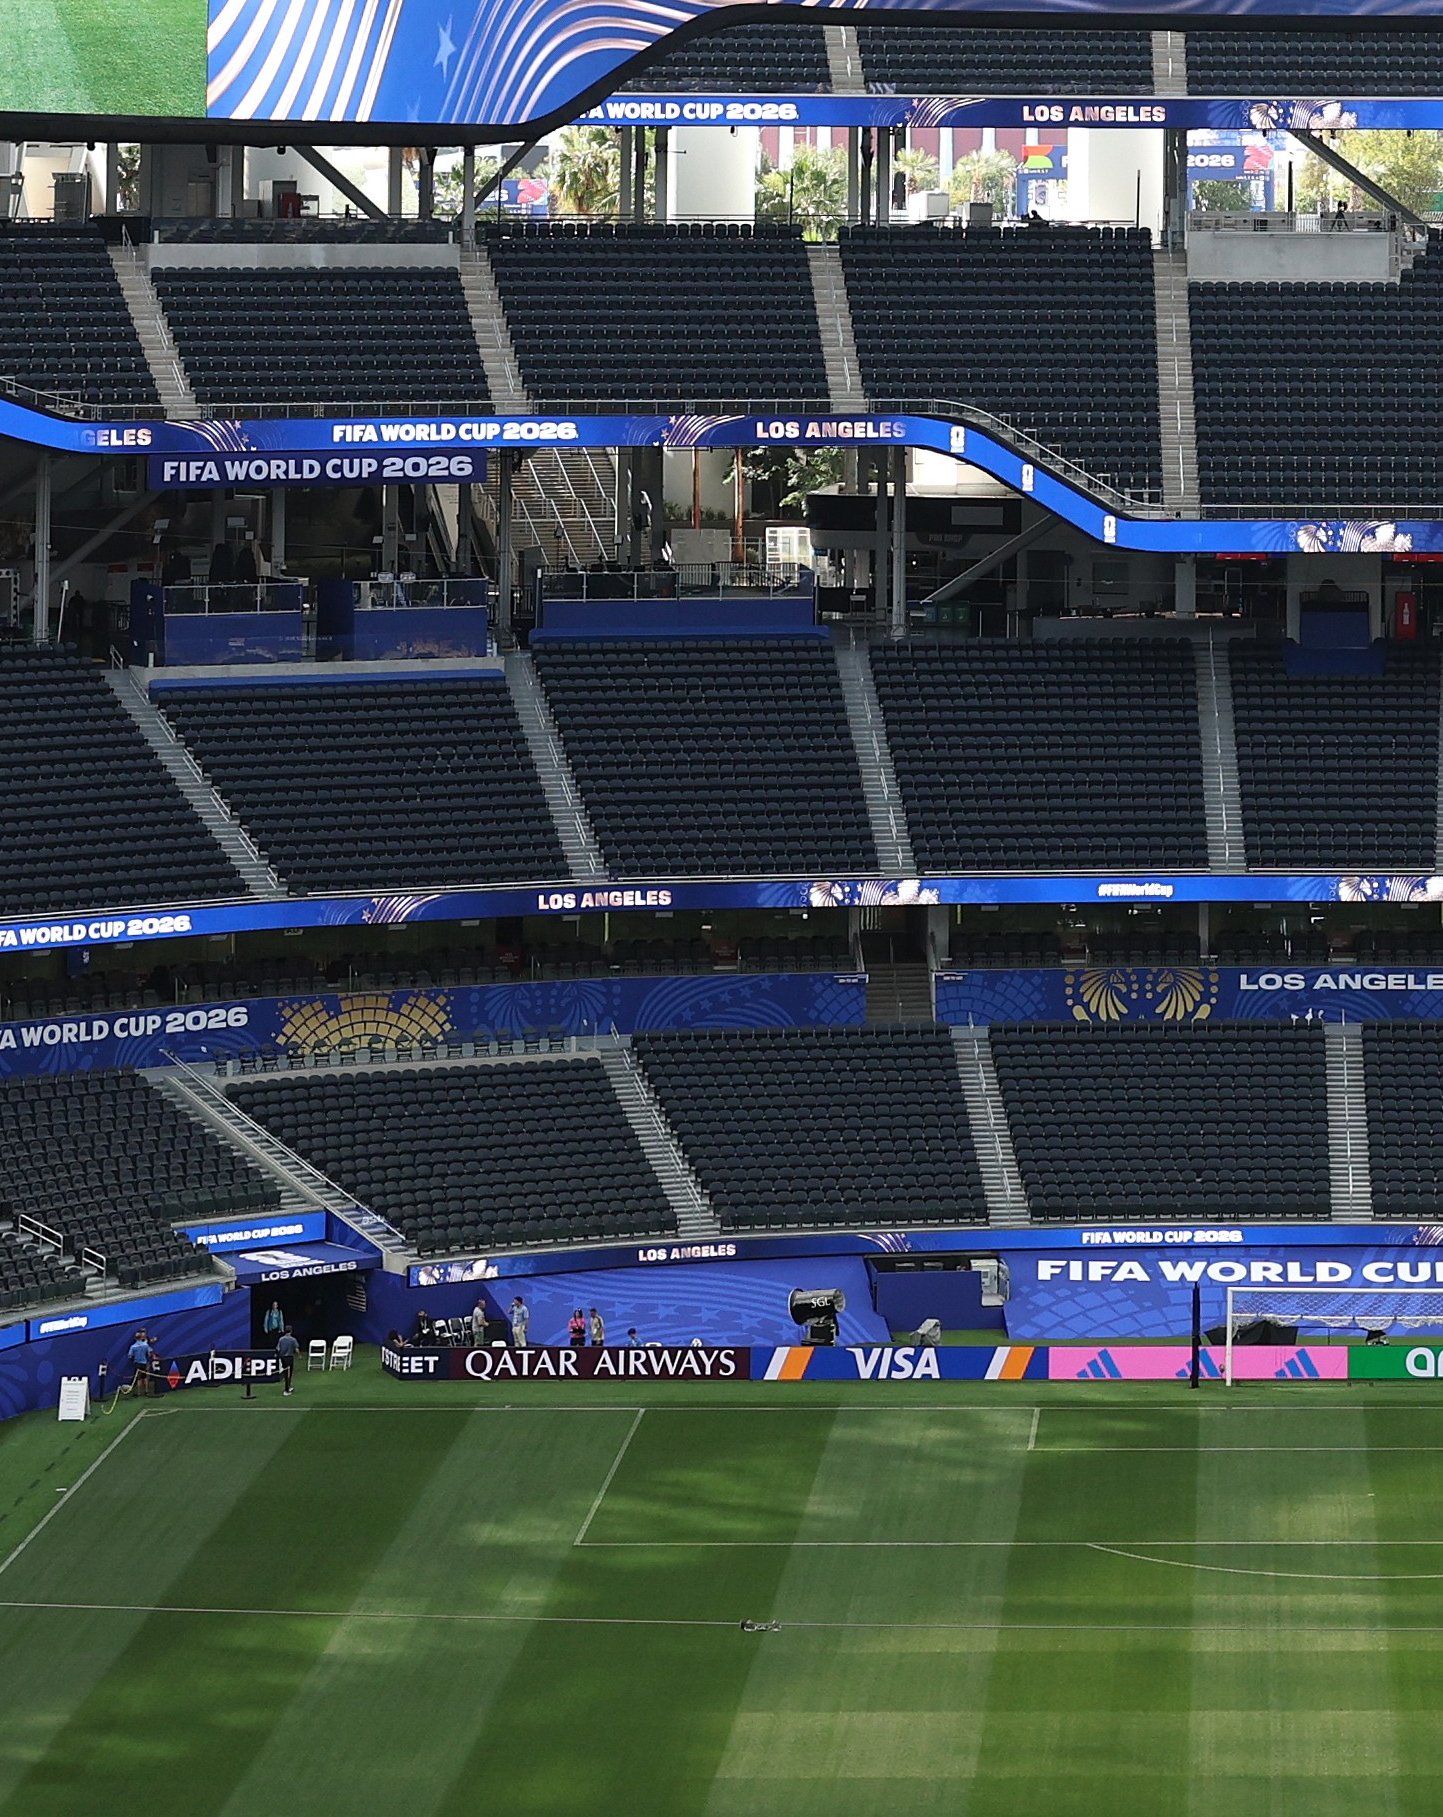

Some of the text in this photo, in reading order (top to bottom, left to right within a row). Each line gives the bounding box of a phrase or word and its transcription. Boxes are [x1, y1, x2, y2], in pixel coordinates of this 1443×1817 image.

[605, 102, 681, 120] WORLD
[682, 102, 724, 120] CUP
[725, 102, 799, 120] 2026
[1022, 105, 1166, 122] LOS ANGELES
[332, 422, 577, 443] FIFA WORLD CUP 2026
[756, 421, 906, 439] LOS ANGELES
[163, 455, 473, 482] FIFA WORLD CUP 2026
[538, 890, 672, 910] LOS ANGELES
[1097, 882, 1174, 898] #FIFAWorldCup
[19, 924, 87, 945] WORLD
[88, 920, 126, 939] CUP
[126, 915, 191, 936] 2026
[1239, 973, 1306, 991] LOS
[20, 1020, 110, 1048] WORLD
[113, 1014, 162, 1038] CUP
[165, 1006, 249, 1034] 2026
[1082, 1231, 1117, 1245] FIFA
[1164, 1230, 1193, 1243] CUP
[638, 1243, 736, 1262] LOS ANGELES
[261, 1261, 357, 1282] LOS ANGELES
[1037, 1260, 1151, 1282] FIFA
[1158, 1260, 1352, 1283] WORLD
[810, 1296, 831, 1308] SGL
[185, 1357, 243, 1384] ADI
[465, 1349, 736, 1381] QATAR AIRWAYS
[845, 1347, 941, 1380] VISA
